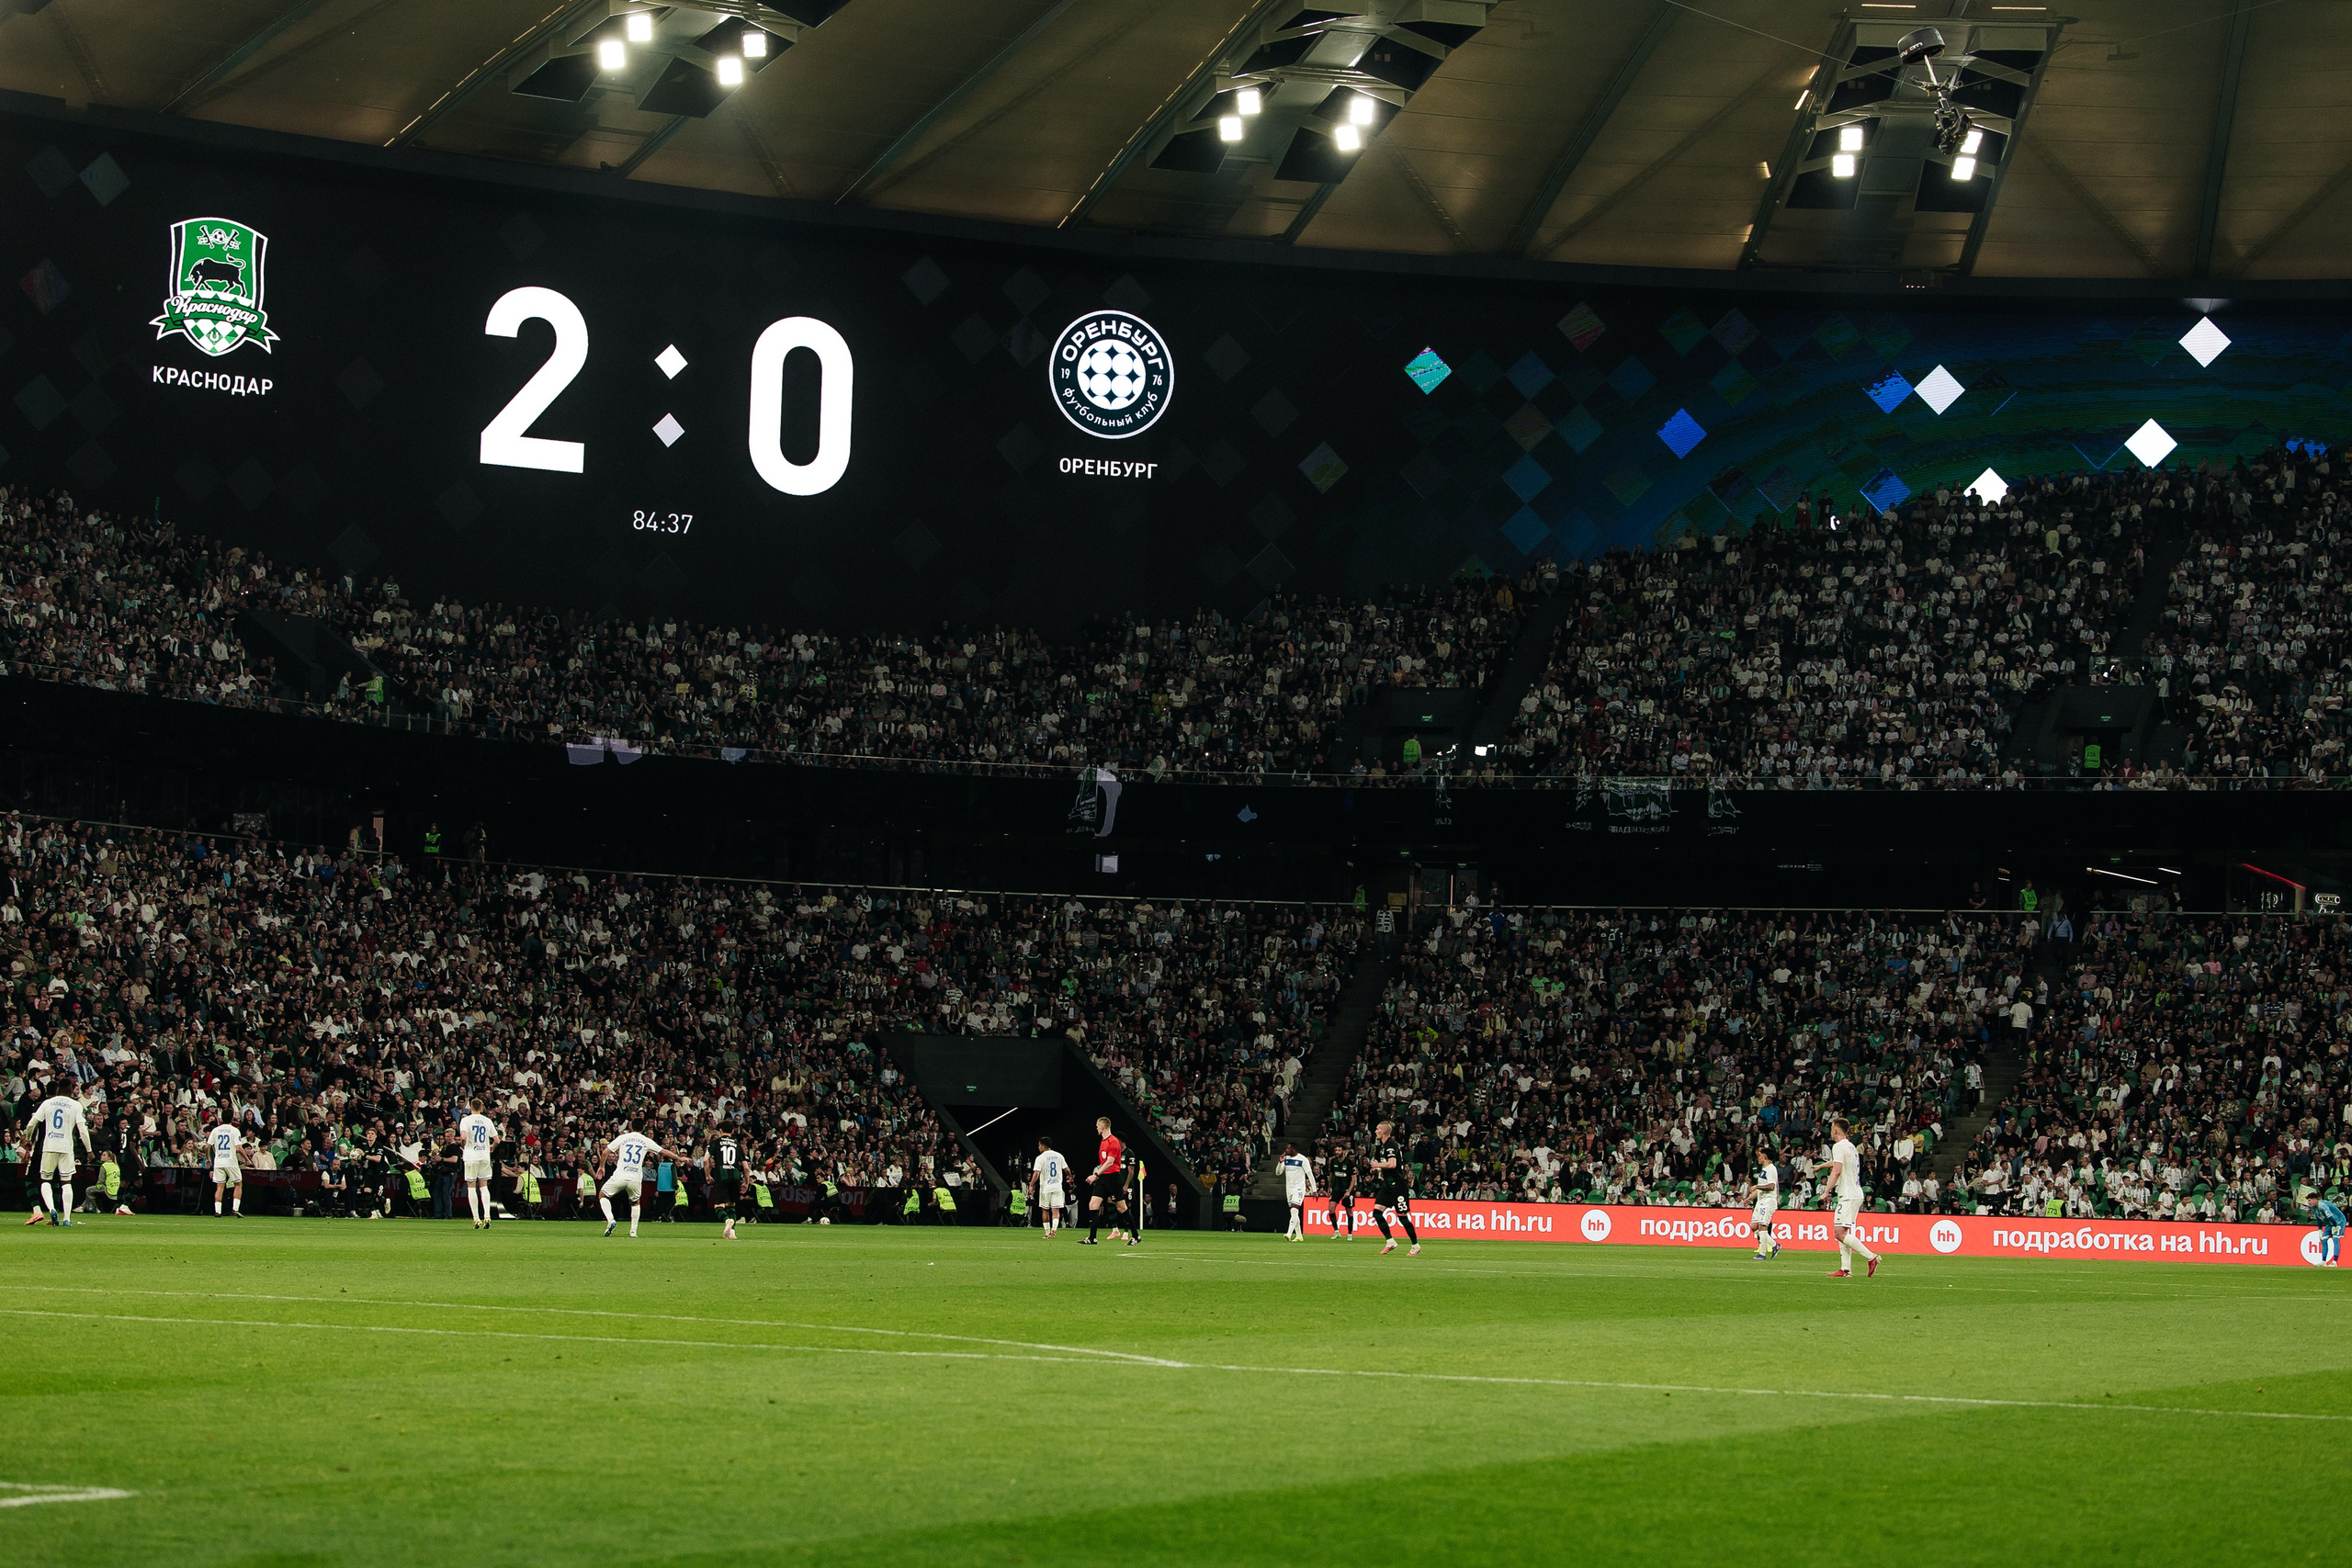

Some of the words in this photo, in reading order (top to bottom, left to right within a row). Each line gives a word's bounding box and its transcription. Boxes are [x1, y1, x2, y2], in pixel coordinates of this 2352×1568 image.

[171, 296, 258, 324] Краснодар
[1062, 320, 1164, 370] ОРЕНБУРГ
[153, 365, 274, 397] КРАСНОДАР
[1061, 367, 1070, 378] 19
[1152, 374, 1162, 386] 76
[481, 287, 588, 473] 2
[749, 317, 854, 497] 0
[1062, 388, 1133, 427] футбольный
[1135, 391, 1159, 420] клуб
[1059, 457, 1158, 479] ОРЕНБУРГ
[633, 510, 694, 535] 84:37
[53, 1108, 63, 1130] 6
[217, 1134, 231, 1150] 22
[471, 1125, 486, 1144] 78
[623, 1144, 643, 1164] 33
[720, 1145, 736, 1166] 10
[1049, 1161, 1057, 1178] 8
[1397, 1201, 1408, 1212] 53
[1759, 1207, 1766, 1216] 16
[1457, 1213, 1486, 1231] на
[1490, 1210, 1553, 1233] hh.ru
[1588, 1219, 1605, 1231] hh
[1640, 1215, 1793, 1242] подрабока
[1798, 1224, 1829, 1241] на
[1834, 1222, 1900, 1245] h.ru
[1938, 1229, 1955, 1242] hh
[1993, 1226, 2155, 1254] подработка
[2161, 1235, 2193, 1253] на
[2199, 1230, 2268, 1256] hh.ru
